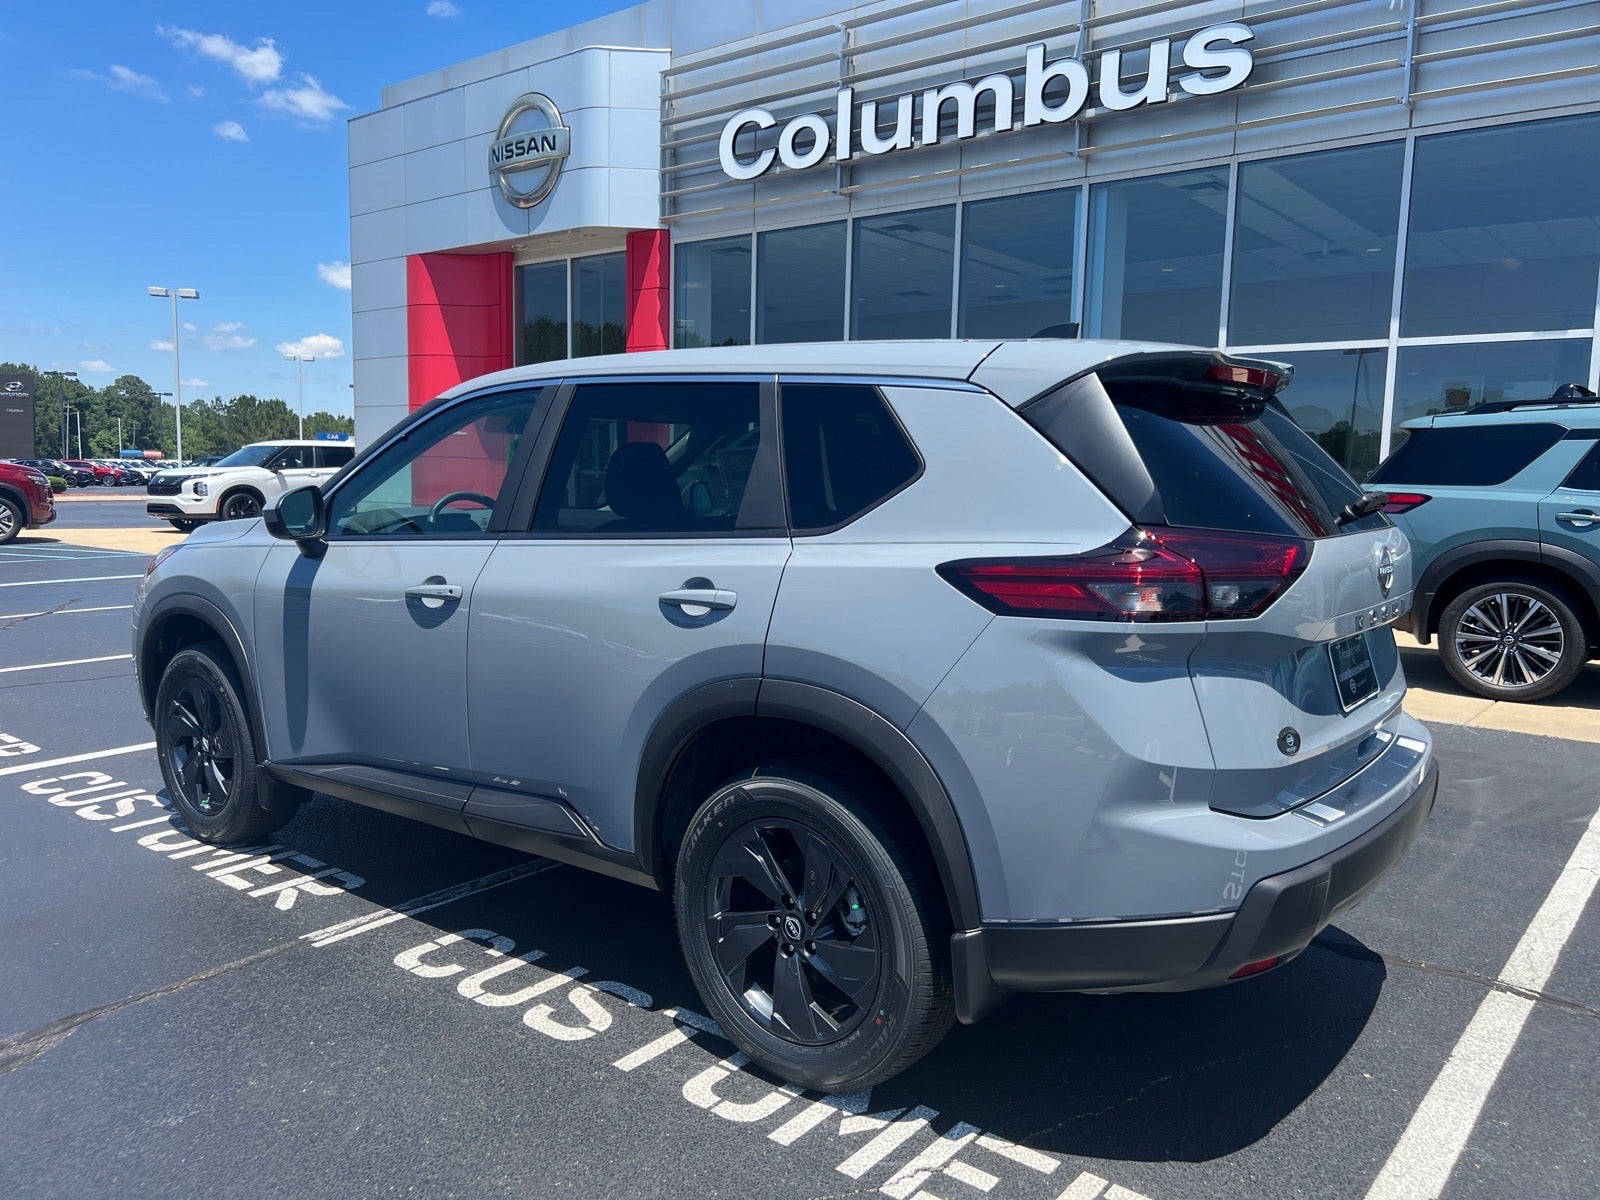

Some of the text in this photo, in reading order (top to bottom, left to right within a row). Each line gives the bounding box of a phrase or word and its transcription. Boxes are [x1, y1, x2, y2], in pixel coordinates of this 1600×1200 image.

[492, 134, 556, 163] NISSAN
[718, 21, 1256, 181] Columbus
[20, 771, 366, 911] CUSTOMER
